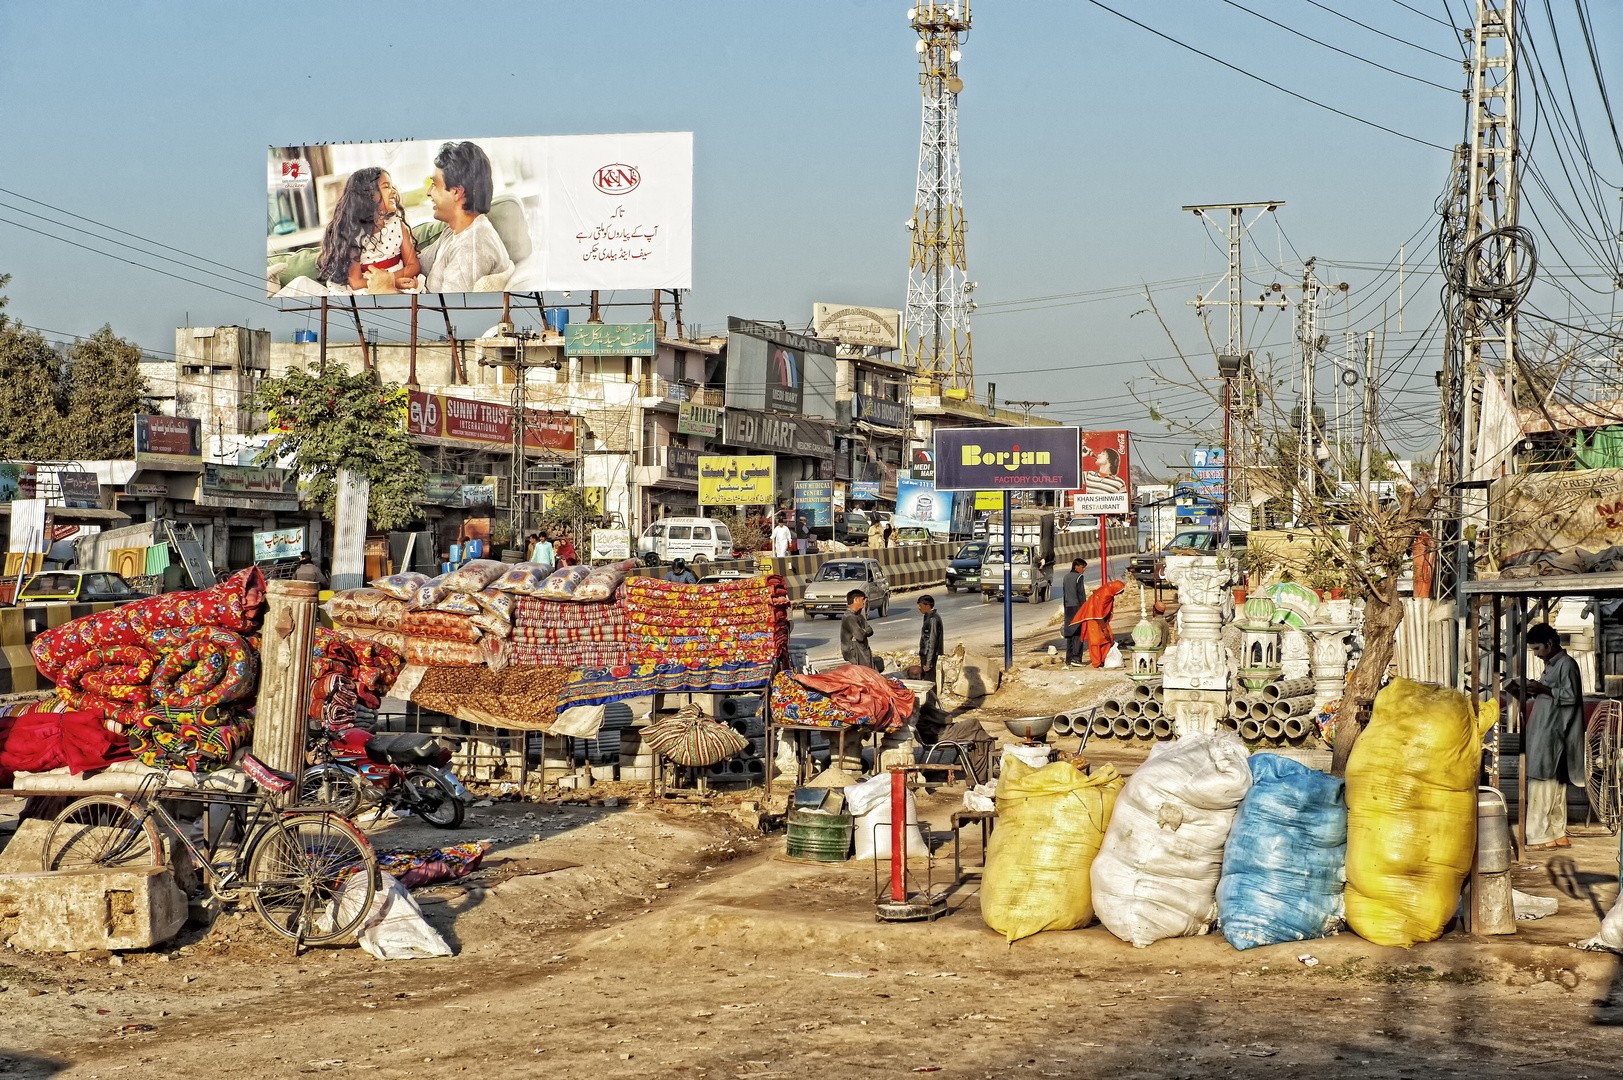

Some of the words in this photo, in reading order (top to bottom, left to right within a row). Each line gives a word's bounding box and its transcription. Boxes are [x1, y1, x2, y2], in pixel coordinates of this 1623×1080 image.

[610, 205, 625, 219] تاکہ
[576, 232, 593, 243] رہے
[593, 222, 604, 240] ملتی
[603, 224, 612, 238] کو
[608, 228, 630, 241] پیاروں
[631, 225, 643, 238] کے
[644, 225, 659, 243] آپ
[583, 242, 599, 261] چکن
[618, 248, 631, 260] اینڈ
[631, 248, 652, 260] سیف
[583, 326, 620, 348] میڈیکل
[620, 328, 652, 346] آصف
[740, 321, 780, 342] MEDI
[785, 334, 827, 353] MART
[772, 389, 783, 401] MEDI
[785, 391, 798, 403] MART
[447, 399, 478, 420] SUNNY
[480, 405, 508, 424] TRUST
[691, 406, 715, 424] PRIMEX
[882, 403, 906, 424] HOSPITA
[460, 420, 498, 433] INTERNATIONAL
[726, 413, 758, 443] MEDI
[762, 418, 796, 448] MART
[687, 452, 698, 465] Medi
[962, 445, 1050, 471] Borjan
[701, 459, 738, 482] ٹرسٹ
[740, 463, 770, 481] سنی
[994, 476, 1030, 484] FACTORY
[1032, 475, 1063, 483] OUTLET
[1562, 476, 1616, 488] PRESTON
[1567, 485, 1619, 497] UNIVSITY
[288, 529, 302, 544] ملک
